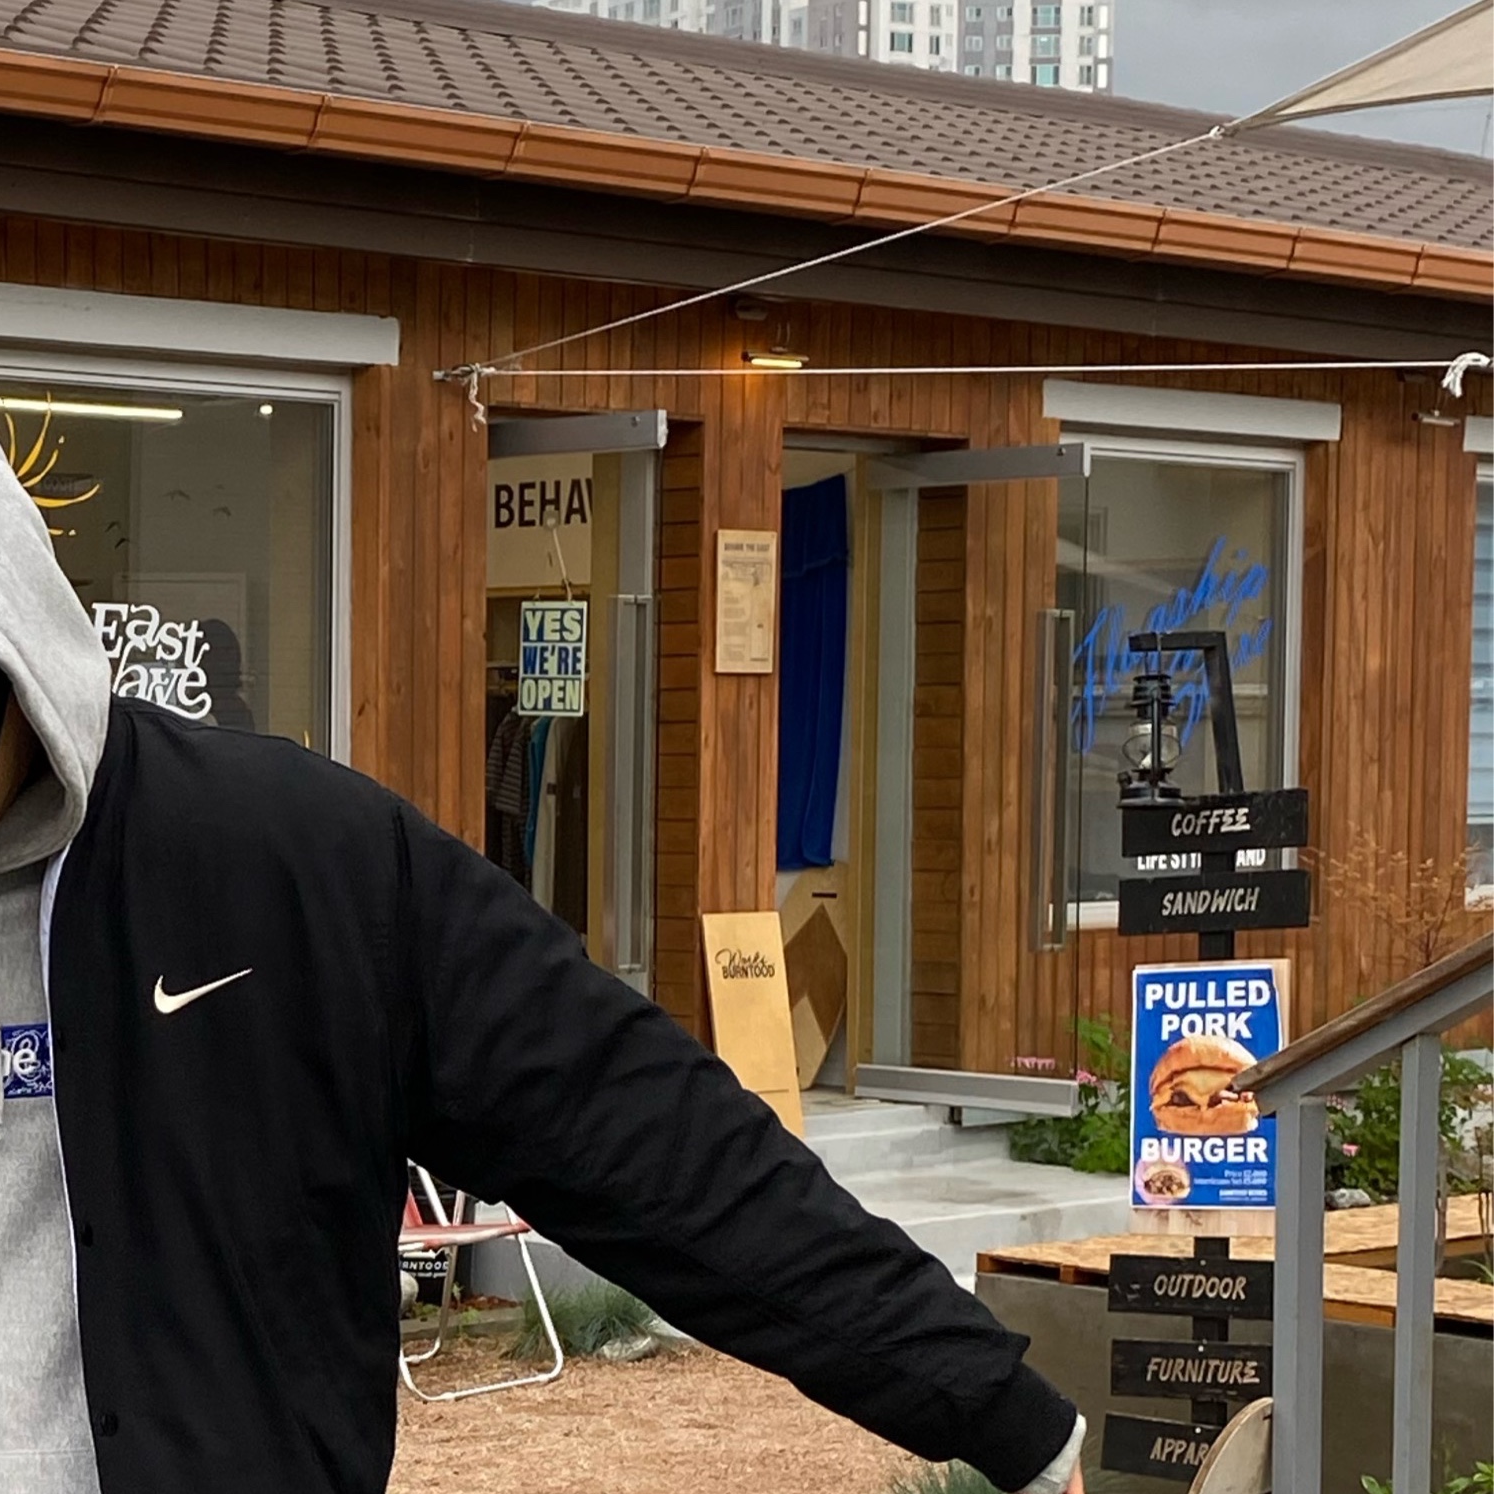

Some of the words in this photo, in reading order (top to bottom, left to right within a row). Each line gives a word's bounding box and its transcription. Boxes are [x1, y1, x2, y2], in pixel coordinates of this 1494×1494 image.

[91, 602, 210, 669] East
[524, 609, 582, 642] YES
[522, 644, 583, 676] WE'RE
[112, 645, 213, 720] ave
[521, 678, 581, 711] OPEN
[1170, 806, 1251, 837] COFFEE
[1235, 848, 1267, 867] AND
[1161, 886, 1260, 917] SANDWICH
[1144, 978, 1272, 1011] PULLED
[1160, 1011, 1254, 1042] PORK
[1140, 1136, 1269, 1164] BURGER
[1153, 1273, 1247, 1300] OUTDOOR
[1145, 1356, 1261, 1385] FURNITURE
[1149, 1436, 1210, 1466] APPAR
